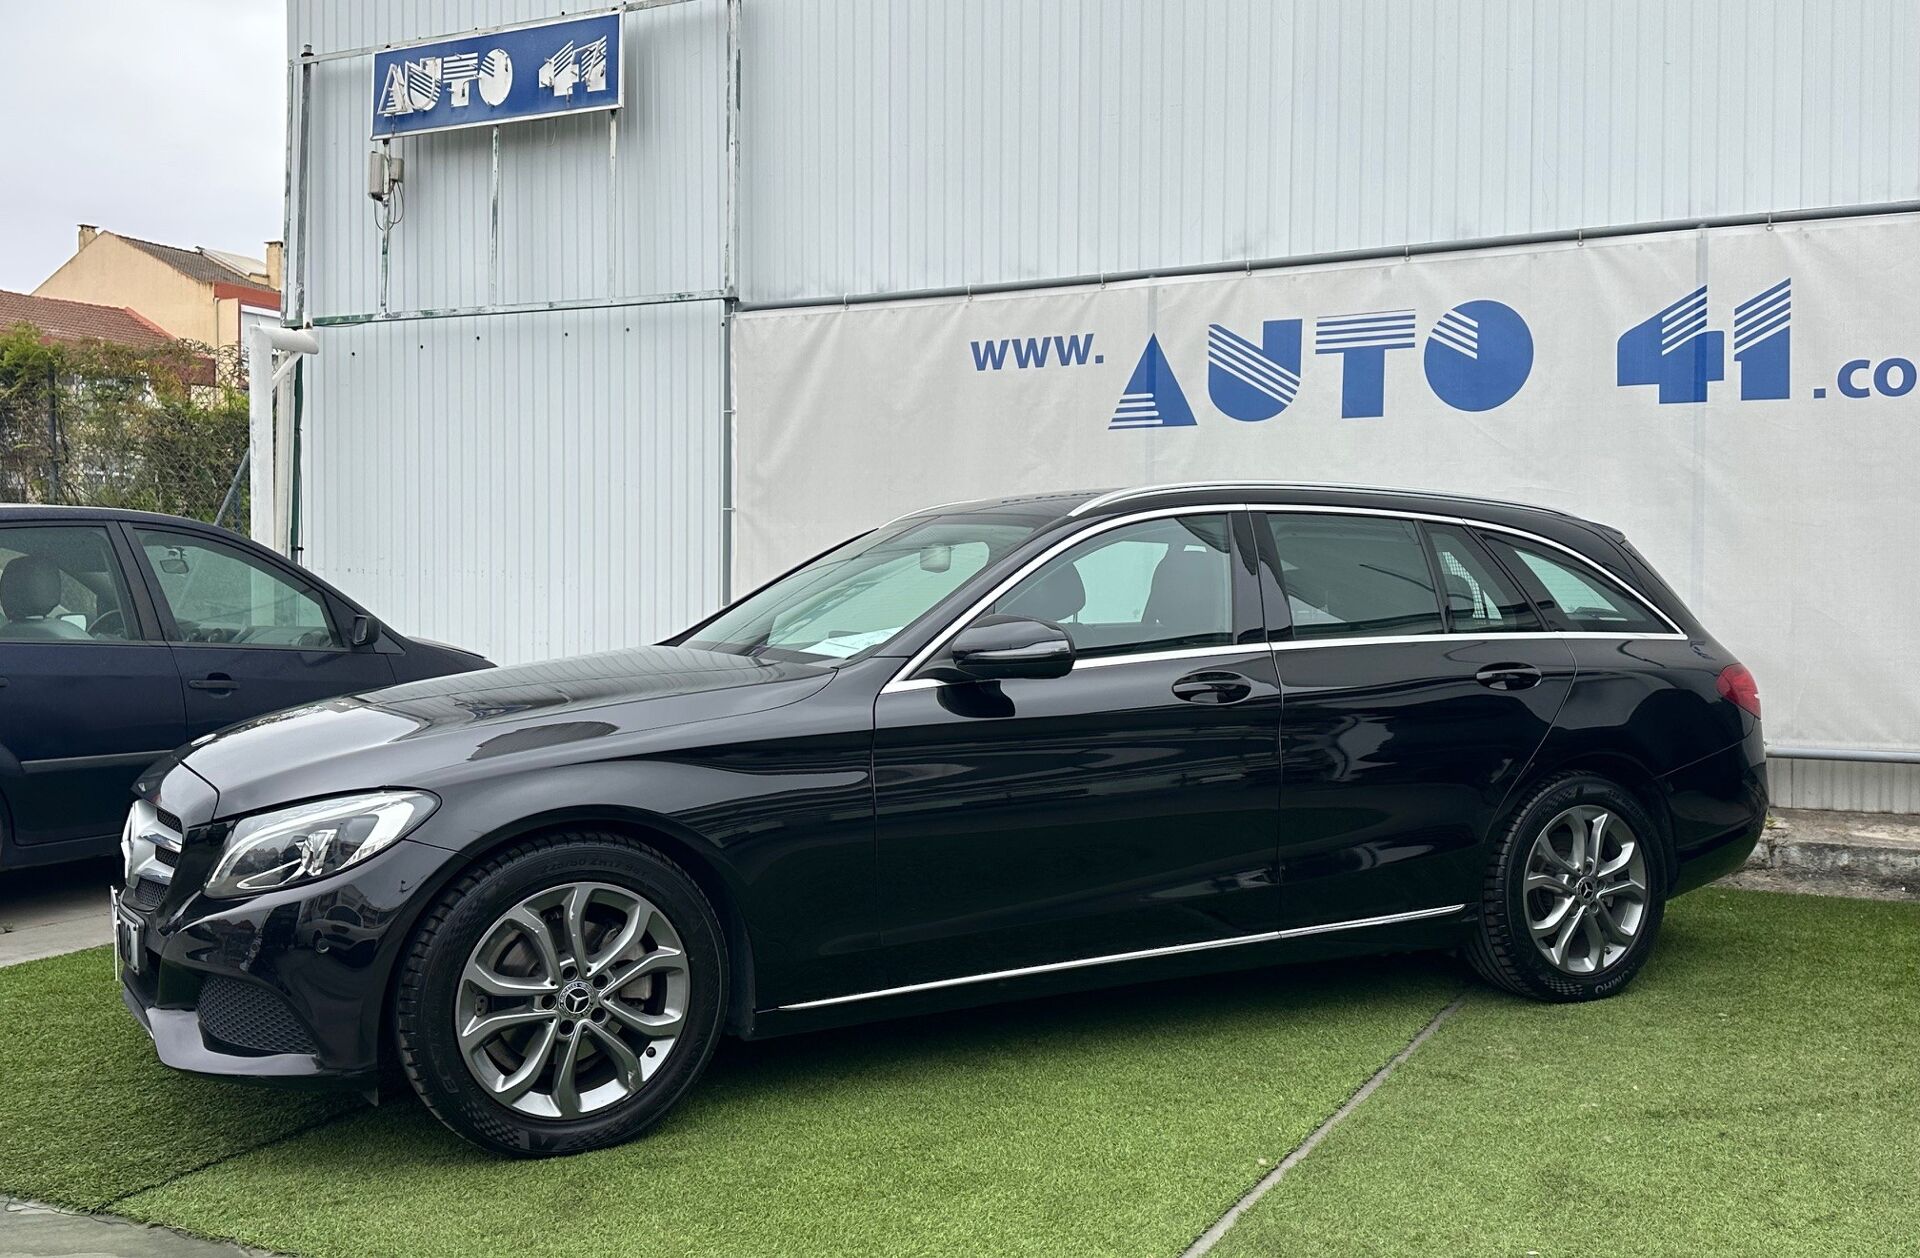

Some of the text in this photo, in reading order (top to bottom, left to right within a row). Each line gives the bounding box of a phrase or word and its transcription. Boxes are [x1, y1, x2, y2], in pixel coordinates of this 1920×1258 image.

[377, 35, 607, 116] AUTO 41
[970, 333, 1104, 371] www.
[1107, 299, 1535, 430] AUTO
[1616, 276, 1792, 405] 41
